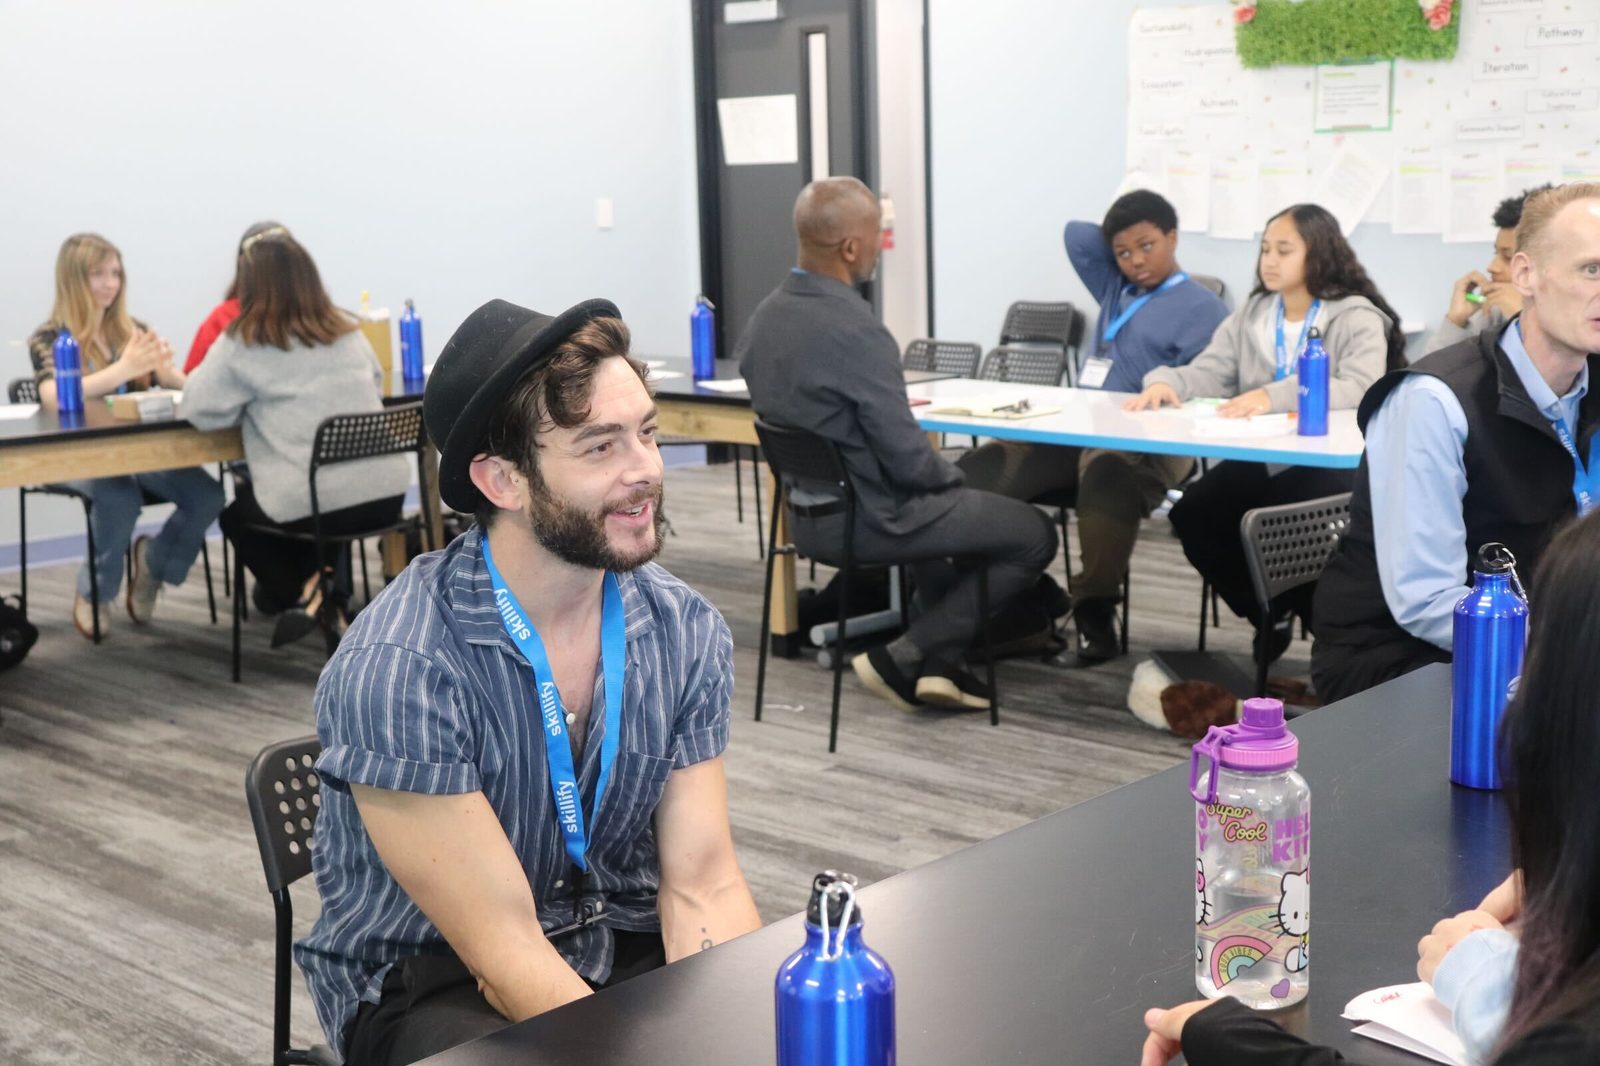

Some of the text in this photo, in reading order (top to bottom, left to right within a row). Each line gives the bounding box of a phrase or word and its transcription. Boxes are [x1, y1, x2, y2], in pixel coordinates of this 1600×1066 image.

[1537, 27, 1584, 39] Pathway
[1482, 62, 1529, 74] Iteration
[494, 588, 531, 641] skillify
[541, 681, 561, 737] skillify
[556, 780, 578, 833] skillify
[1206, 796, 1253, 825] Super
[1224, 821, 1268, 843] Cool
